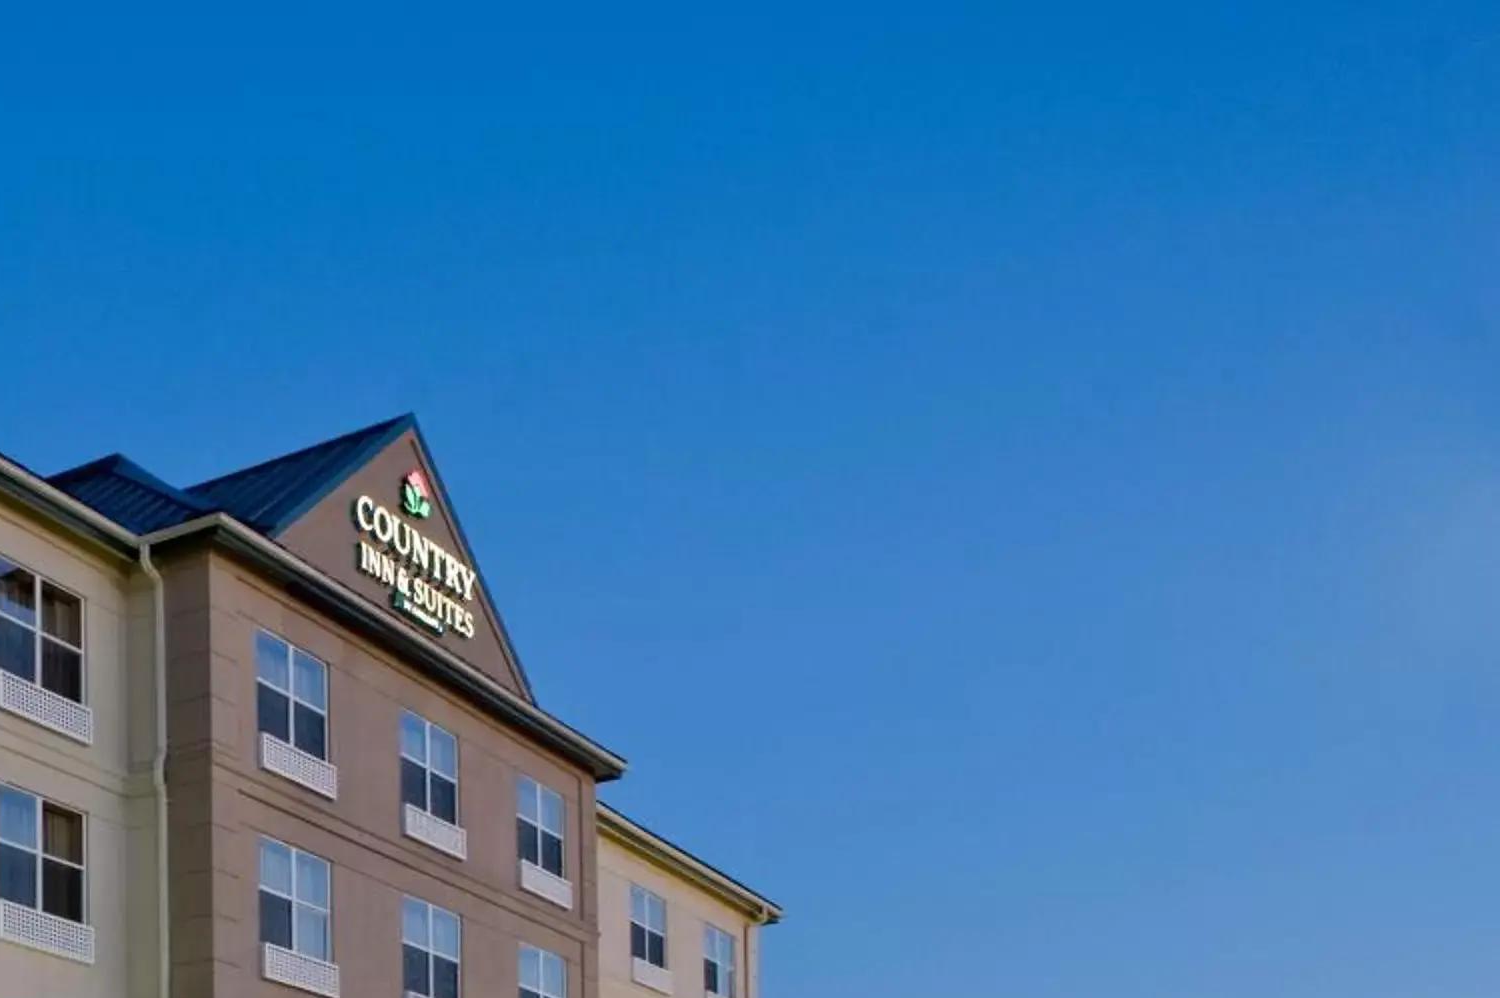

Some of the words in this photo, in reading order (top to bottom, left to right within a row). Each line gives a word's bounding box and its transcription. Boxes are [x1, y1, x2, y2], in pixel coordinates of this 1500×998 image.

[356, 496, 476, 601] COUNTRY
[360, 541, 395, 586] INN
[396, 568, 411, 598] &
[413, 577, 475, 639] SUITES
